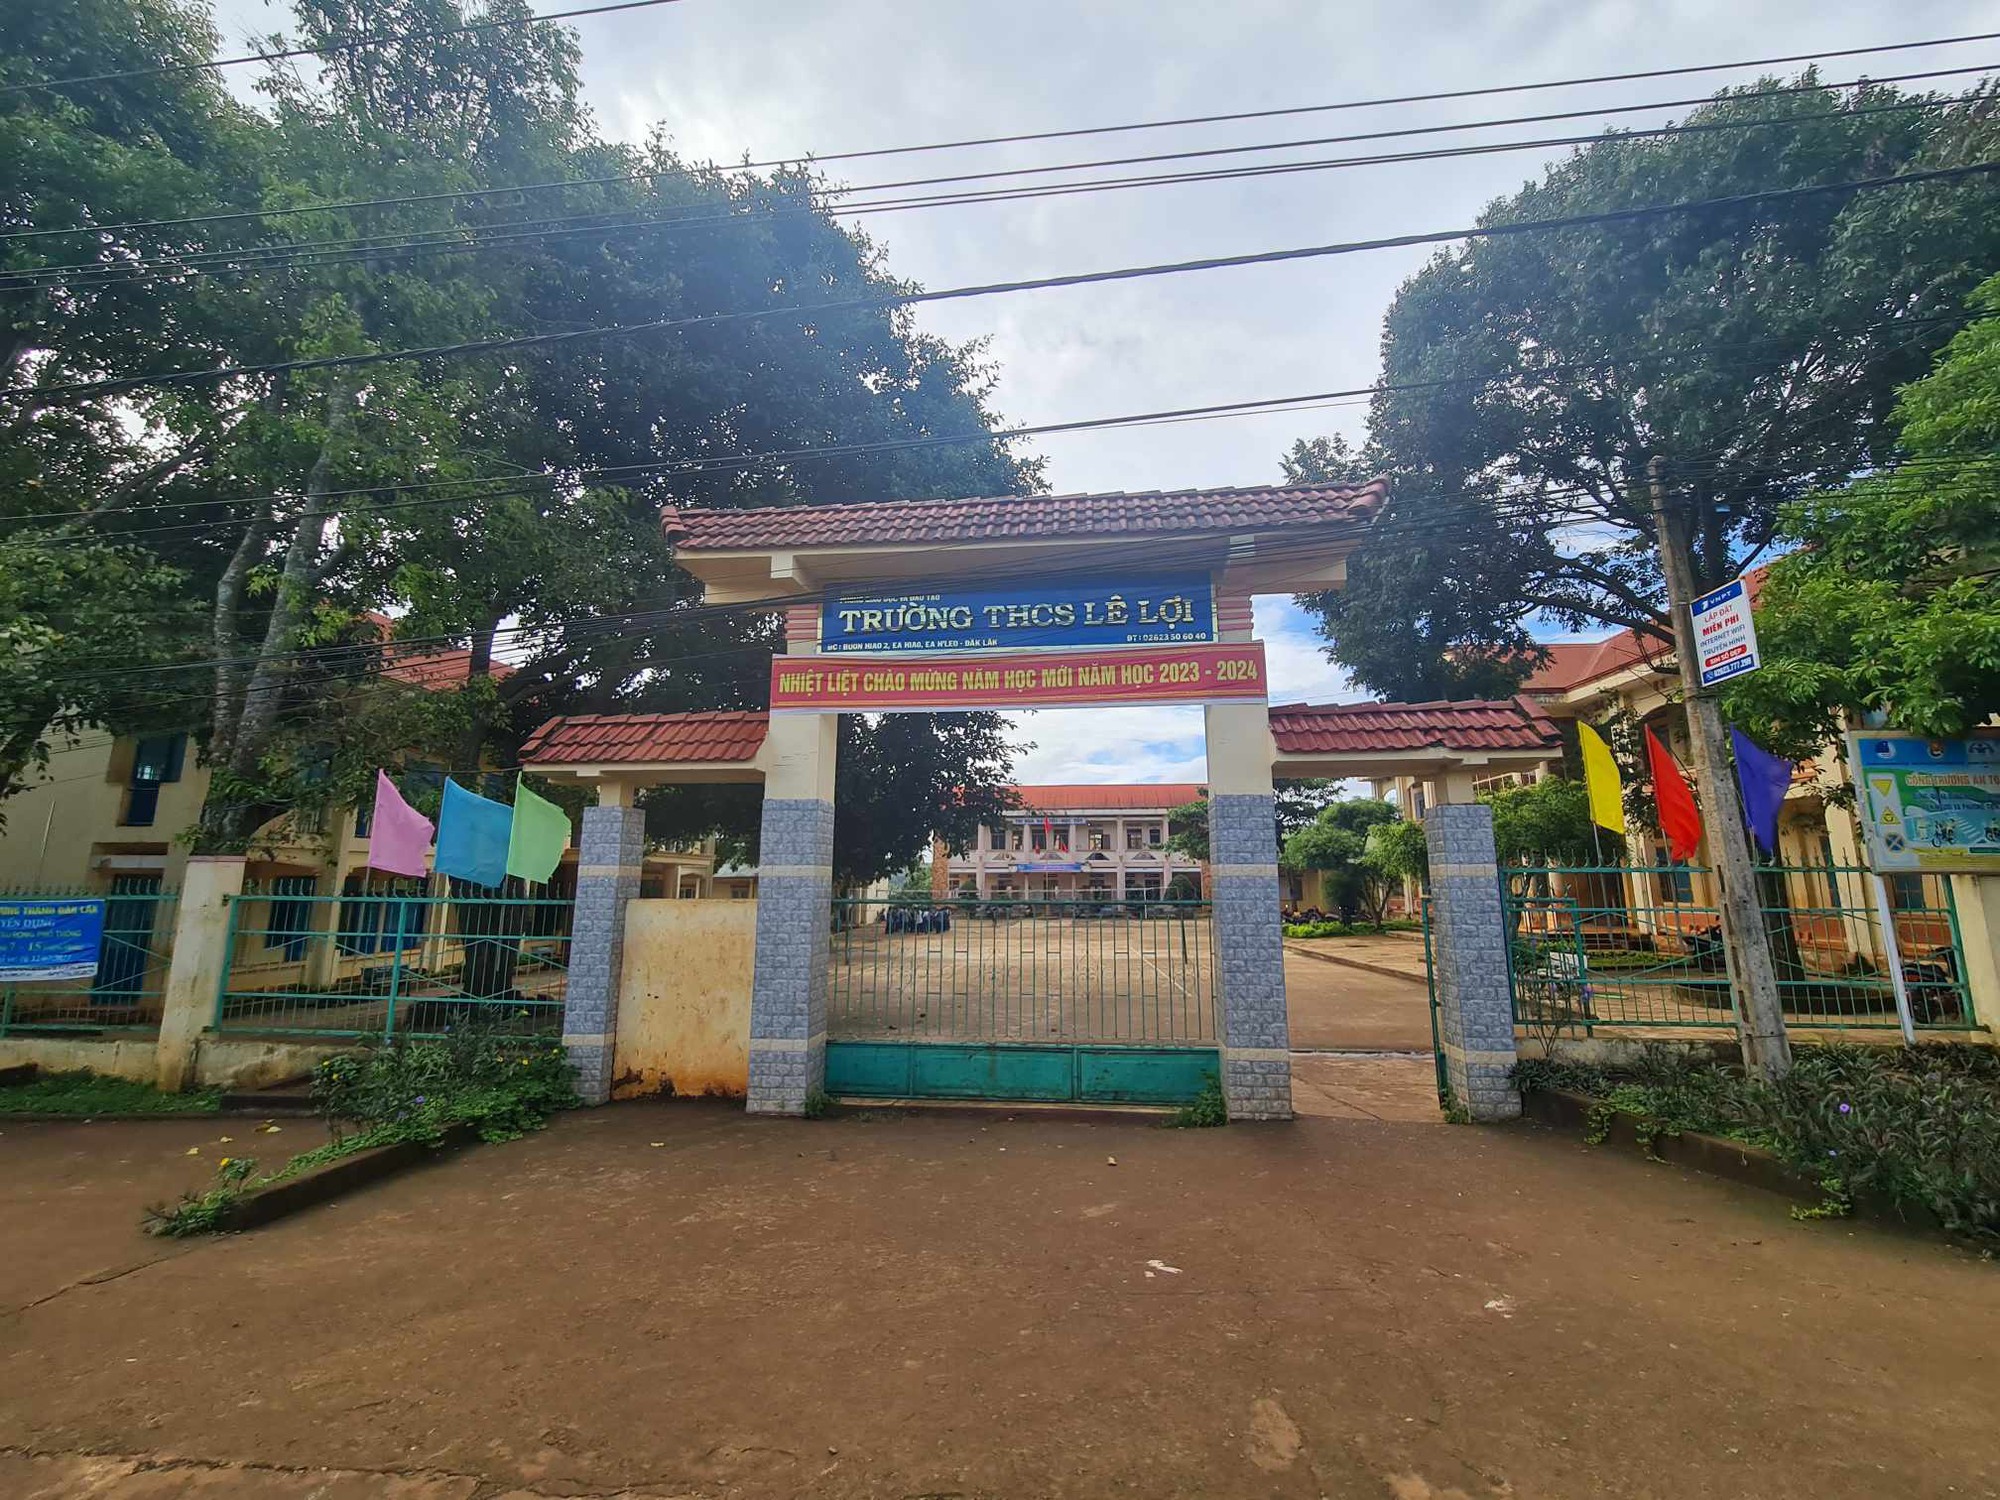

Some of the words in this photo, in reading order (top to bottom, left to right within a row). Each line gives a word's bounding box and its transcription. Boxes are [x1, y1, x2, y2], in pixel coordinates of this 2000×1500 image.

[1710, 591, 1731, 604] VNPT
[839, 601, 973, 632] TRƯỜNG
[983, 603, 1074, 628] THCS
[1084, 594, 1128, 625] LÊ
[1138, 595, 1195, 629] LỢI
[1170, 633, 1181, 641] 50
[1182, 632, 1194, 640] 60
[1195, 632, 1206, 640] 40
[779, 669, 824, 697] NHIỆT
[827, 669, 859, 697] LIỆT
[863, 669, 905, 692] CHÀO
[910, 668, 958, 692] MỪNG
[962, 667, 1000, 690] NĂM
[1004, 668, 1036, 692] HỌC
[1041, 664, 1073, 688] MỚI
[1078, 661, 1116, 686] NĂM
[1121, 663, 1154, 688] HỌC
[1159, 661, 1199, 684] 2023
[1216, 660, 1258, 681] 2024
